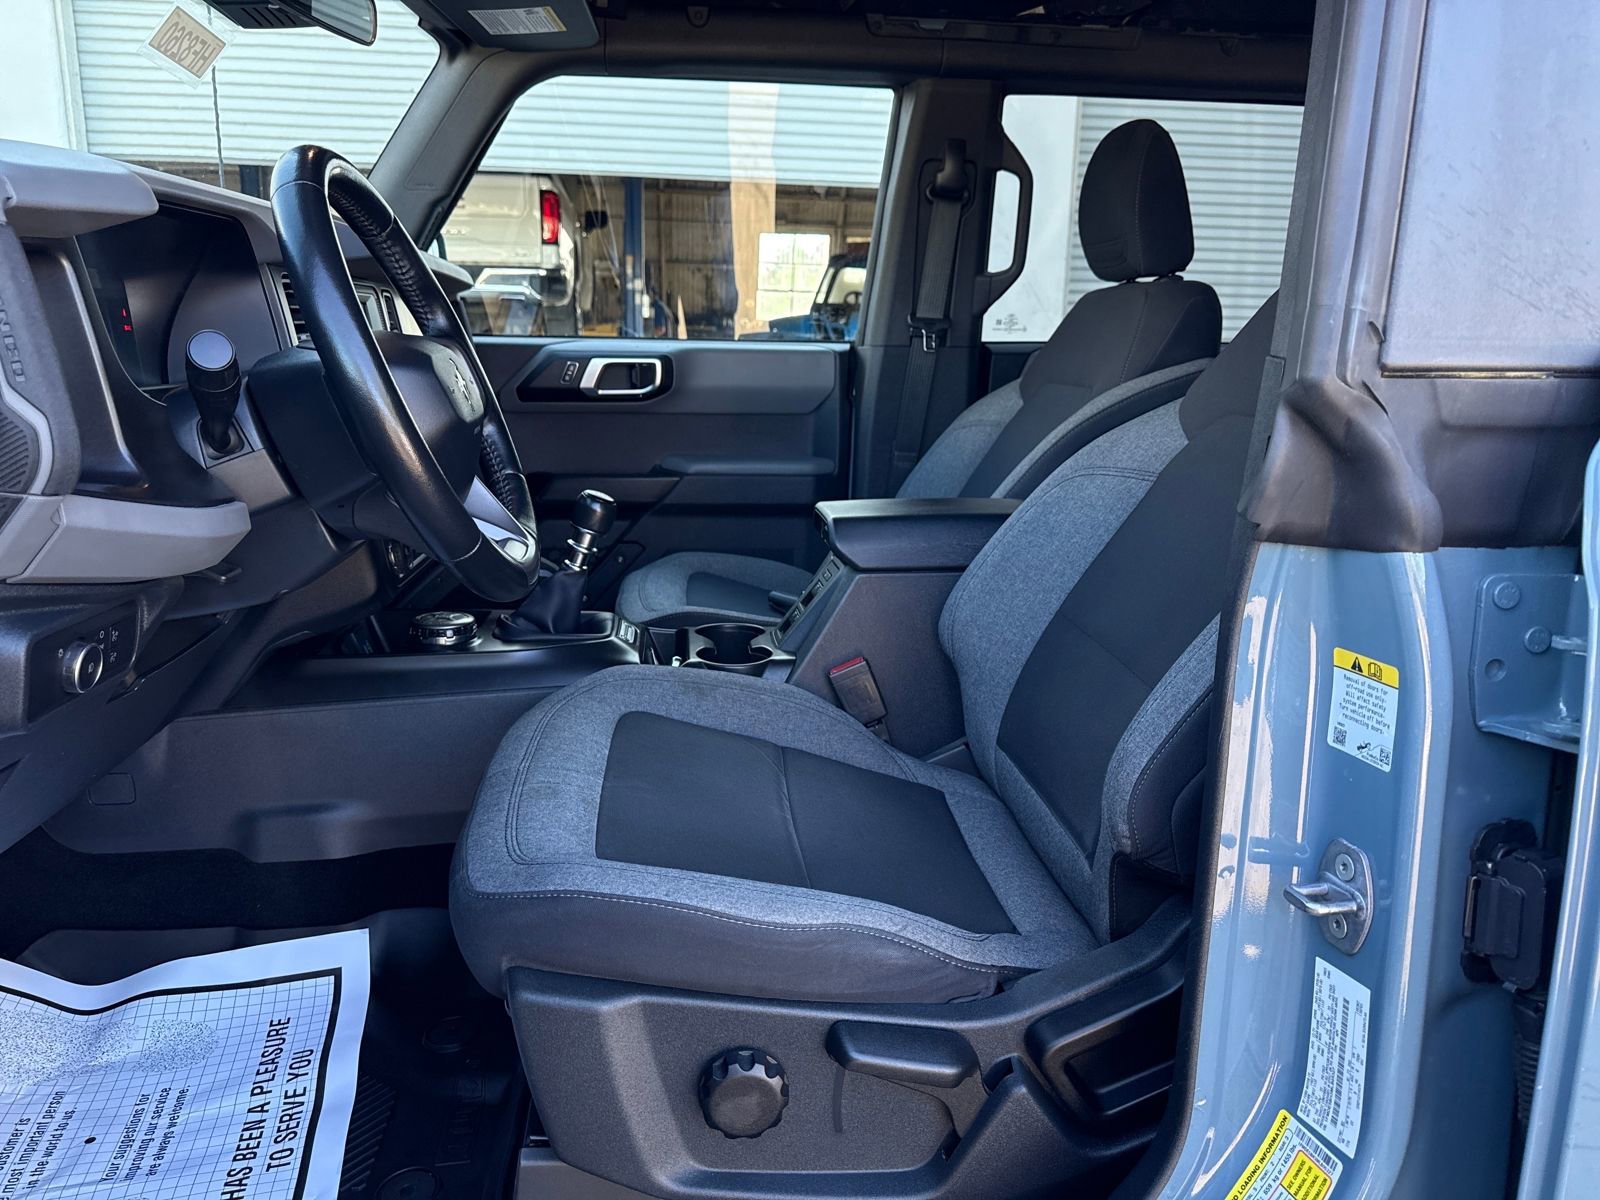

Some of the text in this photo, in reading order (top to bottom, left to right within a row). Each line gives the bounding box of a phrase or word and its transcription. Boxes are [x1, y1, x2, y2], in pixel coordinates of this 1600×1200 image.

[0, 296, 26, 382] NCO
[1343, 673, 1360, 685] Removal
[1367, 682, 1380, 692] doors
[13, 1121, 50, 1165] important
[15, 1117, 31, 1126] is
[43, 1091, 66, 1119] person
[100, 1094, 151, 1183] Your suggestions for
[120, 1087, 172, 1182] improving our service
[146, 1085, 191, 1177] are always welcome.
[221, 1016, 291, 1200] HAS BEEN A PLEASURE
[265, 1049, 314, 1172] TO SERVE YOU
[2, 1167, 25, 1193] most
[22, 1107, 77, 1190] in the world to us.
[1239, 1164, 1261, 1195] LOADING
[1259, 1115, 1288, 1165] INFORMATION
[1272, 1175, 1280, 1183] kg
[1281, 1153, 1292, 1168] 1455
[1293, 1160, 1306, 1180] OWNERS
